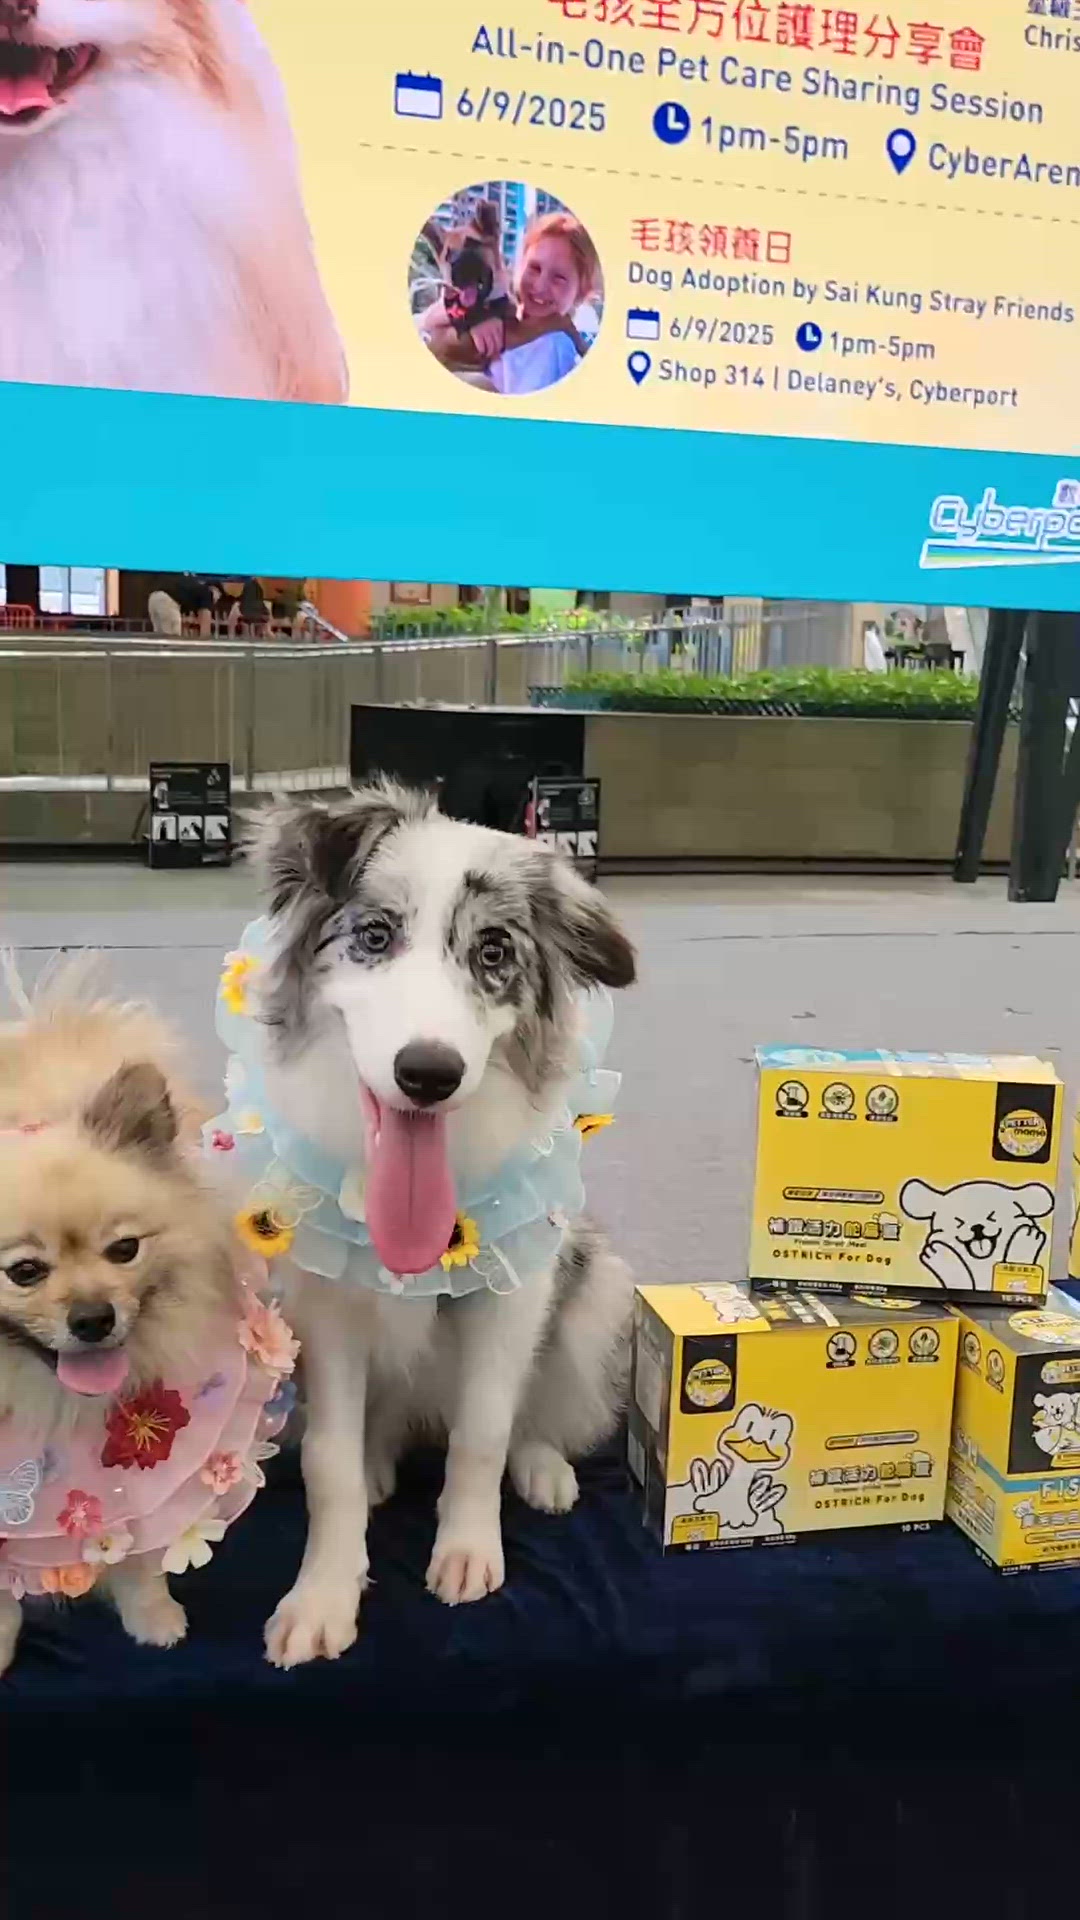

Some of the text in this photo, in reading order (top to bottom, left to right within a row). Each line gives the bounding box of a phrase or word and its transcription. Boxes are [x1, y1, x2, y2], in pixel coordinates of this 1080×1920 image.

[472, 25, 1043, 124] All-in-One Pet Care Sharing Session
[456, 86, 606, 132] 6/9/2025
[701, 116, 848, 162] 1pm-5pm
[631, 218, 791, 264] 毛孩領養日
[628, 261, 1075, 323] Dog Adoption by Sai Kung Stray Friends
[669, 316, 936, 361] 6/9/2025 1pm-5pm
[658, 359, 717, 388] Shop
[724, 364, 765, 386] 314
[788, 369, 902, 401] Delaney's,
[910, 379, 1018, 409] Cyberport
[772, 1249, 891, 1265] OSTRICH For Dog
[815, 1497, 871, 1510] OSTRICH
[901, 1492, 925, 1502] Dog
